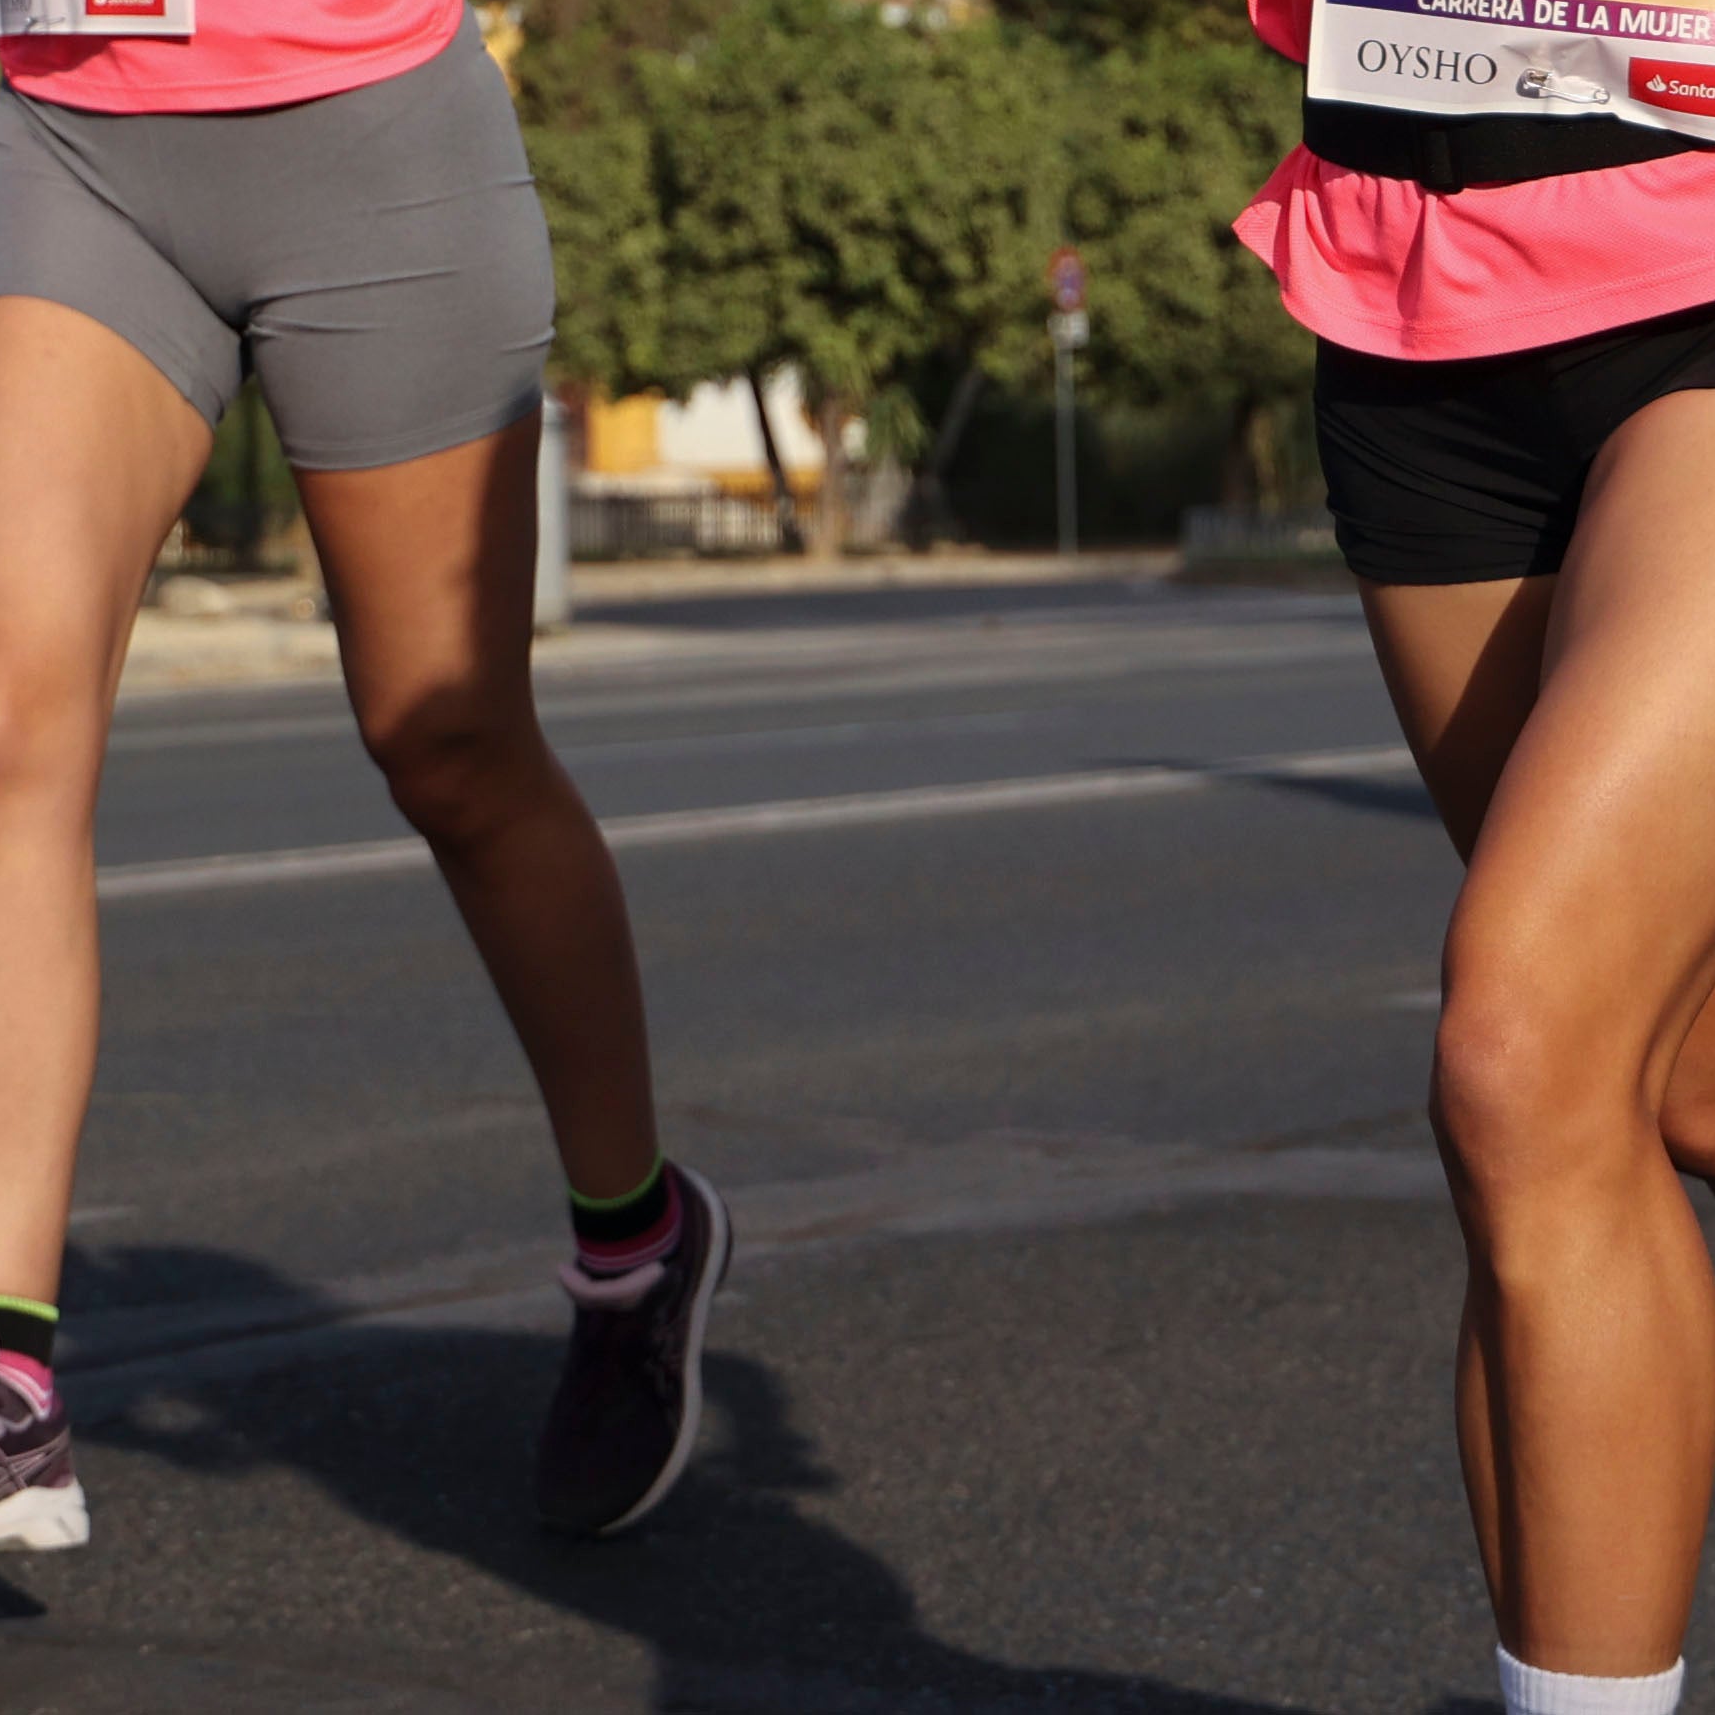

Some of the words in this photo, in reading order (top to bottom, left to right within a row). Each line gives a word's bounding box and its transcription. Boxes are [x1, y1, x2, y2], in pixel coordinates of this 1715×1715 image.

[1533, 0, 1570, 27] DE
[1576, 3, 1610, 32] LA
[1619, 8, 1712, 41] MUJER
[1357, 39, 1498, 85] OYSHO
